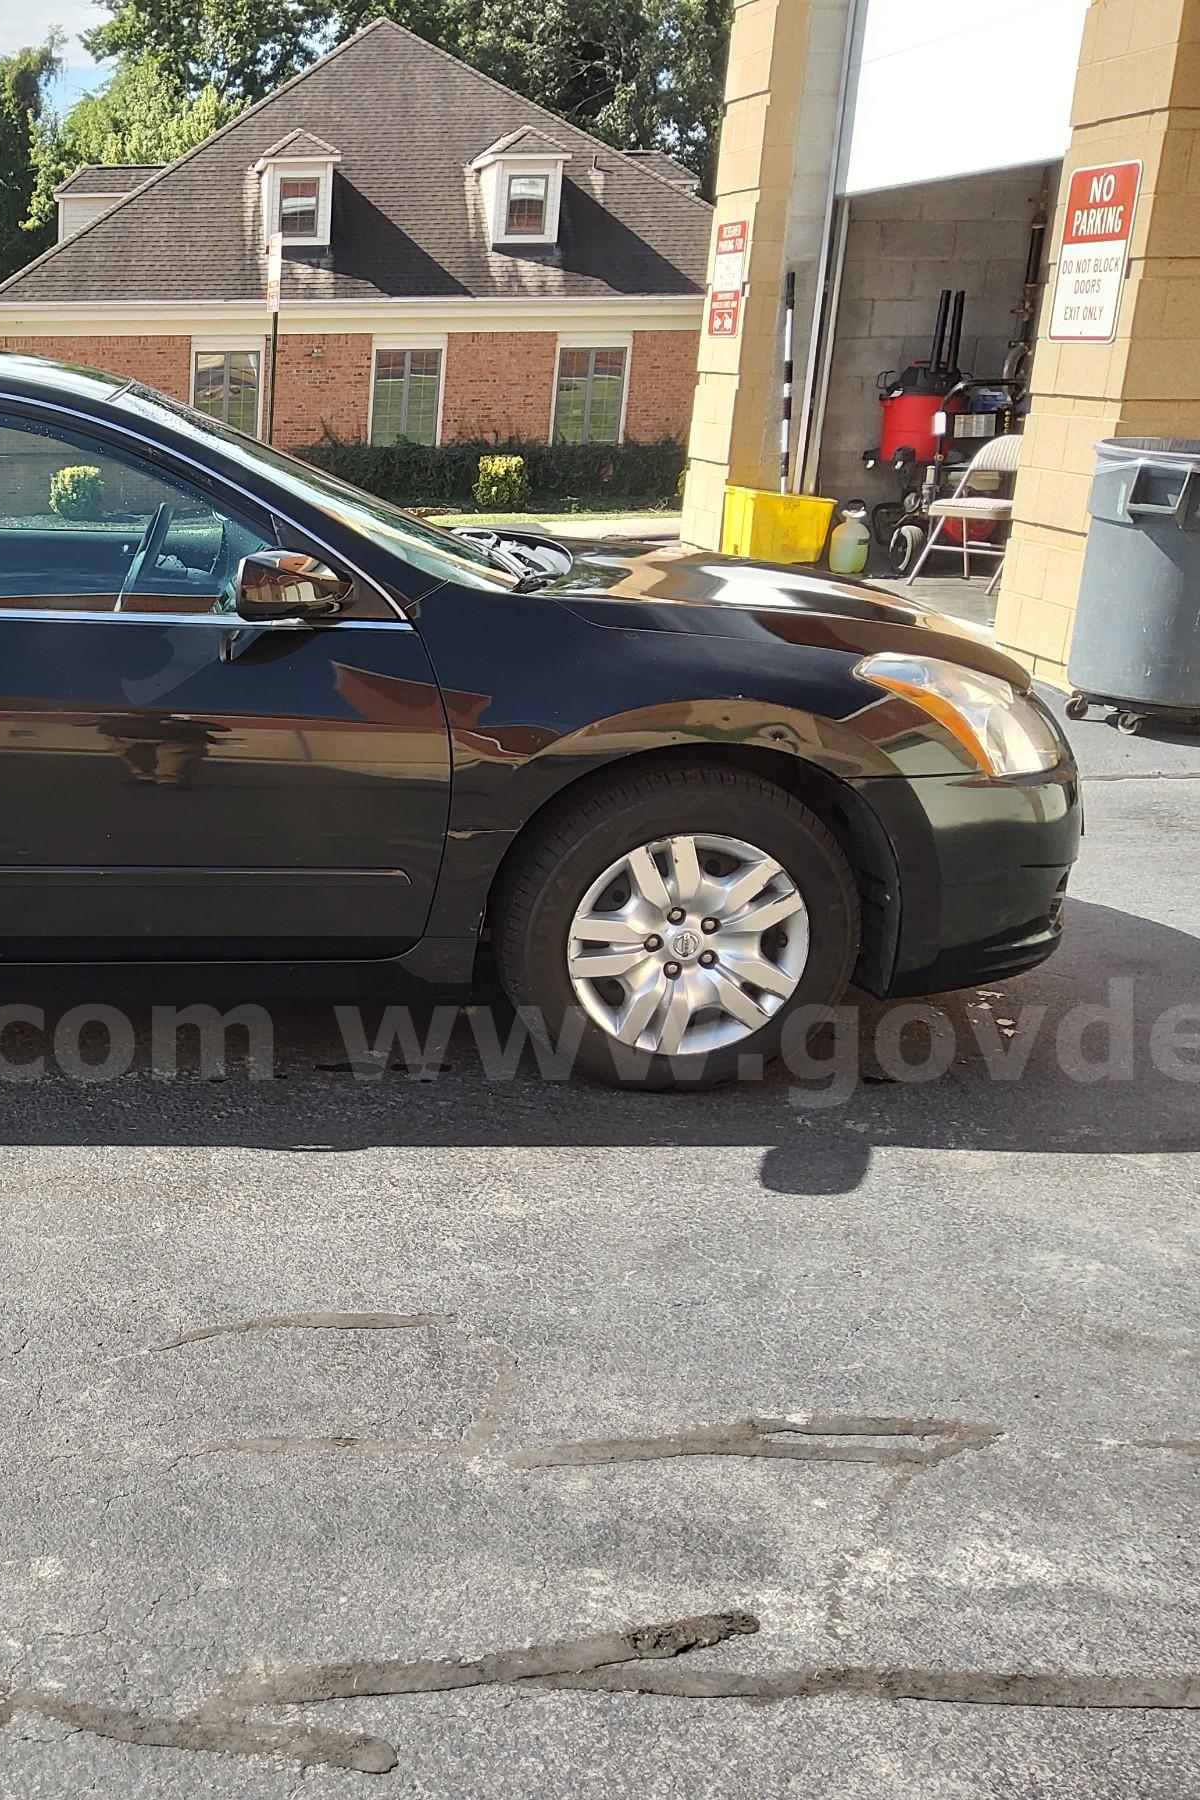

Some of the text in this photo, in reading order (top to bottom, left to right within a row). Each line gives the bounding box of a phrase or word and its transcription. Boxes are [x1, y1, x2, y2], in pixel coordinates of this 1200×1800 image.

[1089, 173, 1116, 203] NO
[1072, 205, 1125, 237] PARKING
[1062, 257, 1121, 275] DO NOT BLOCK
[1074, 279, 1101, 295] DOORS
[1064, 306, 1104, 321] EXIT ONLY
